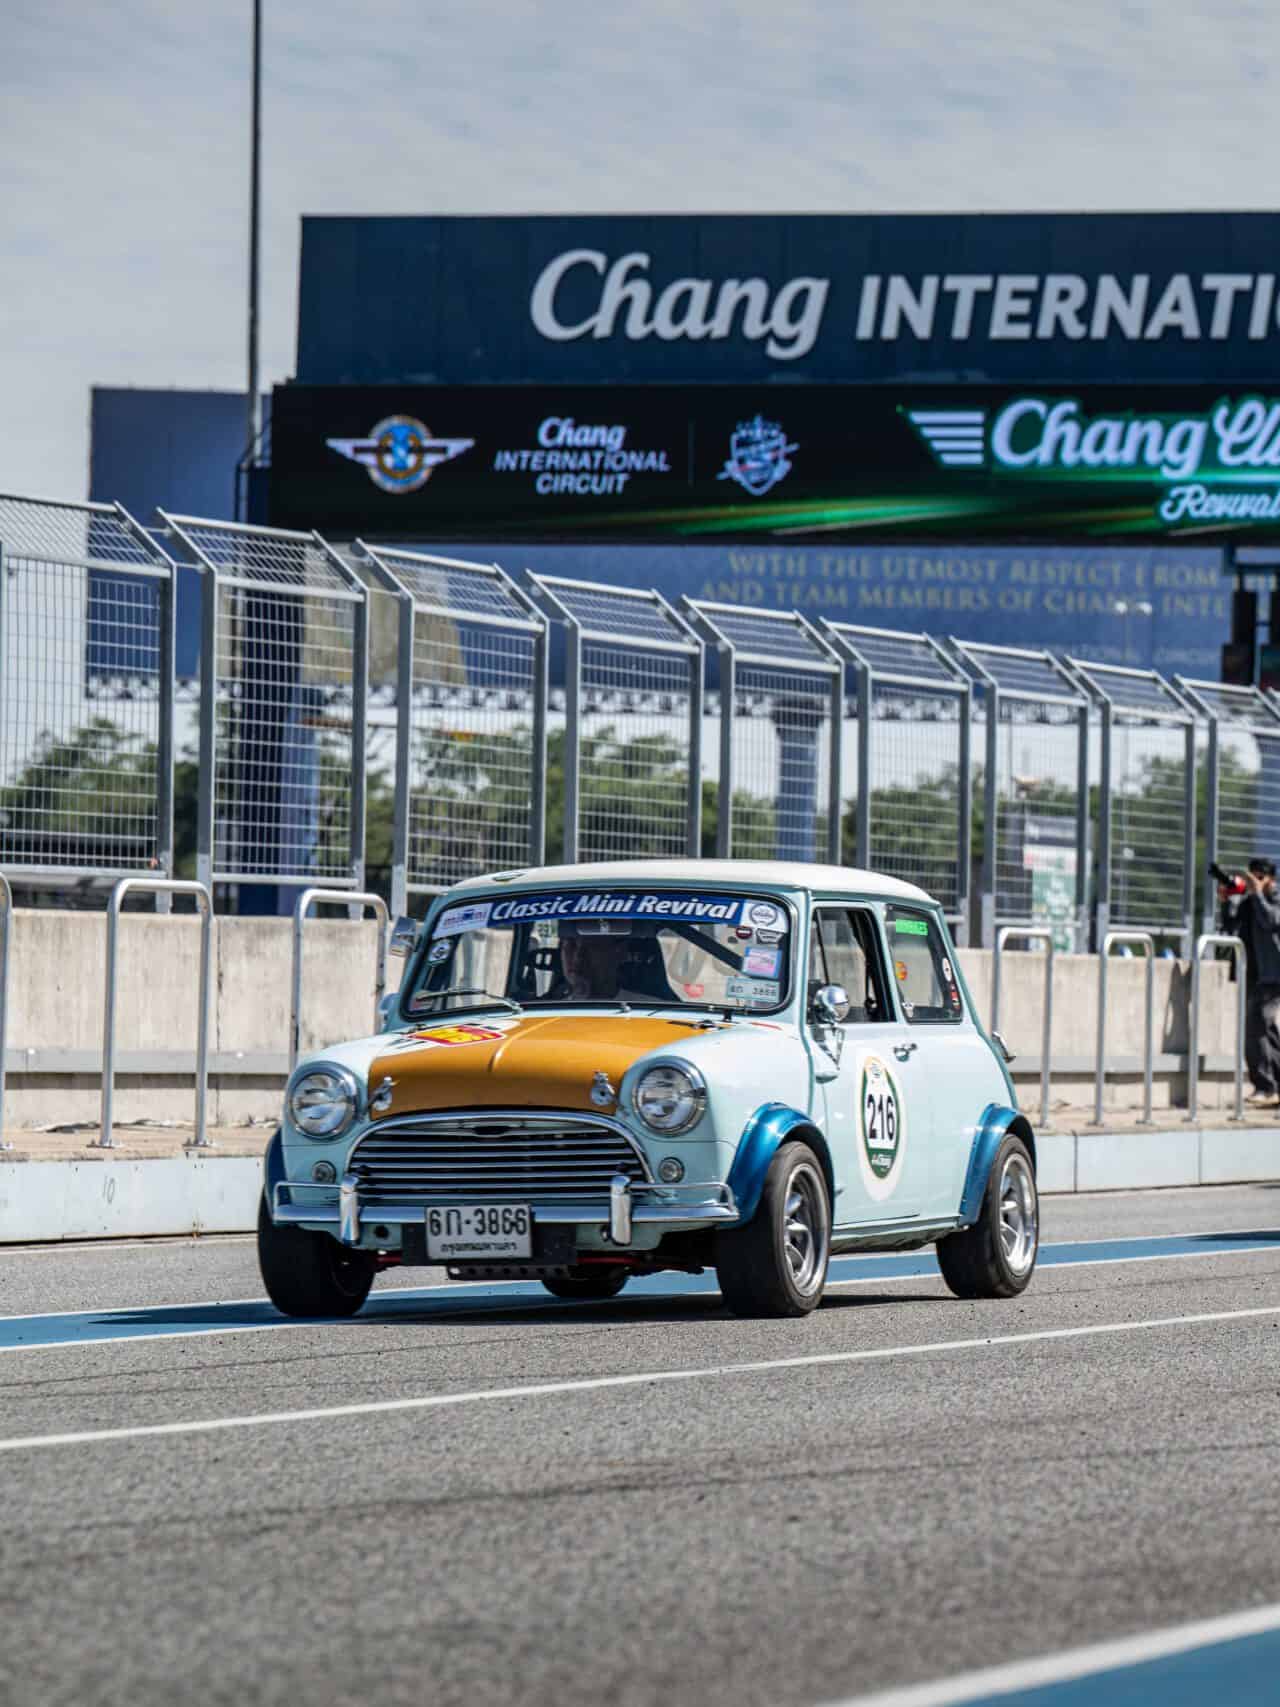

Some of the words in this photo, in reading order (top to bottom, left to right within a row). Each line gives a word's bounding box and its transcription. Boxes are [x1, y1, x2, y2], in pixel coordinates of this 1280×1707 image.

[530, 248, 829, 360] Chang
[537, 416, 627, 452] Chang
[991, 398, 1208, 480] Chang
[494, 450, 672, 472] INTERNATIONAL
[535, 472, 631, 494] CIRCUIT
[728, 550, 807, 577] WITH
[816, 553, 872, 578] THE
[882, 555, 997, 582] UTMOST
[1010, 559, 1122, 587] RESPECT
[1135, 562, 1218, 588] FROM
[775, 582, 849, 606] TEAM
[858, 584, 990, 610] MEMBERS
[491, 896, 573, 921] Classic
[574, 893, 637, 914] Mini
[637, 895, 740, 920] Revival
[867, 1093, 895, 1141] 216
